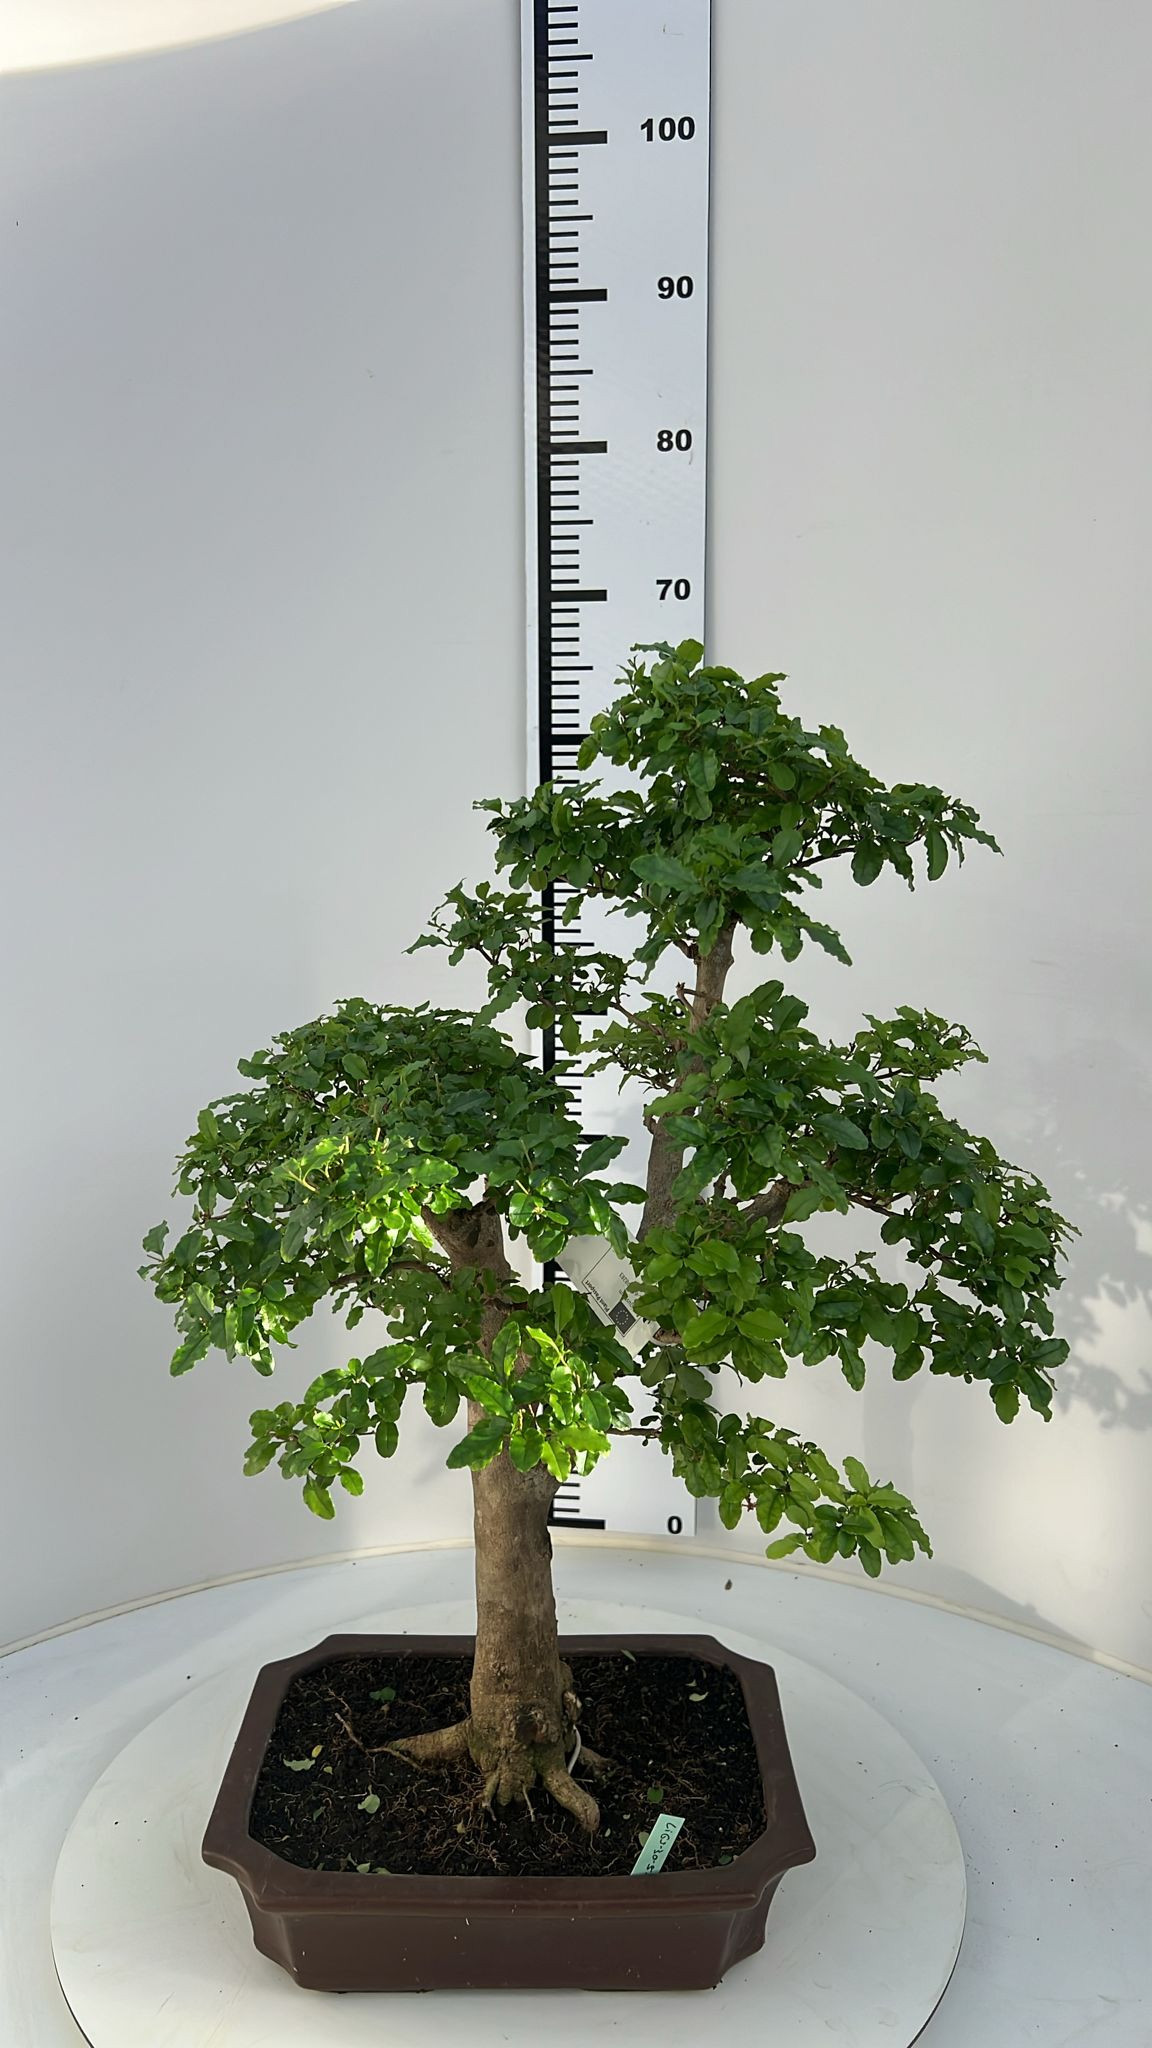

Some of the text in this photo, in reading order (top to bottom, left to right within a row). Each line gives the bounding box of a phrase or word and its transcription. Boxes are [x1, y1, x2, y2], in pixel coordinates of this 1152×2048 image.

[640, 116, 696, 142] 100
[657, 275, 694, 300] 90
[656, 429, 693, 453] 80
[655, 578, 691, 601] 70
[585, 1280, 610, 1312] Plant Passport
[667, 1515, 683, 1535] 0
